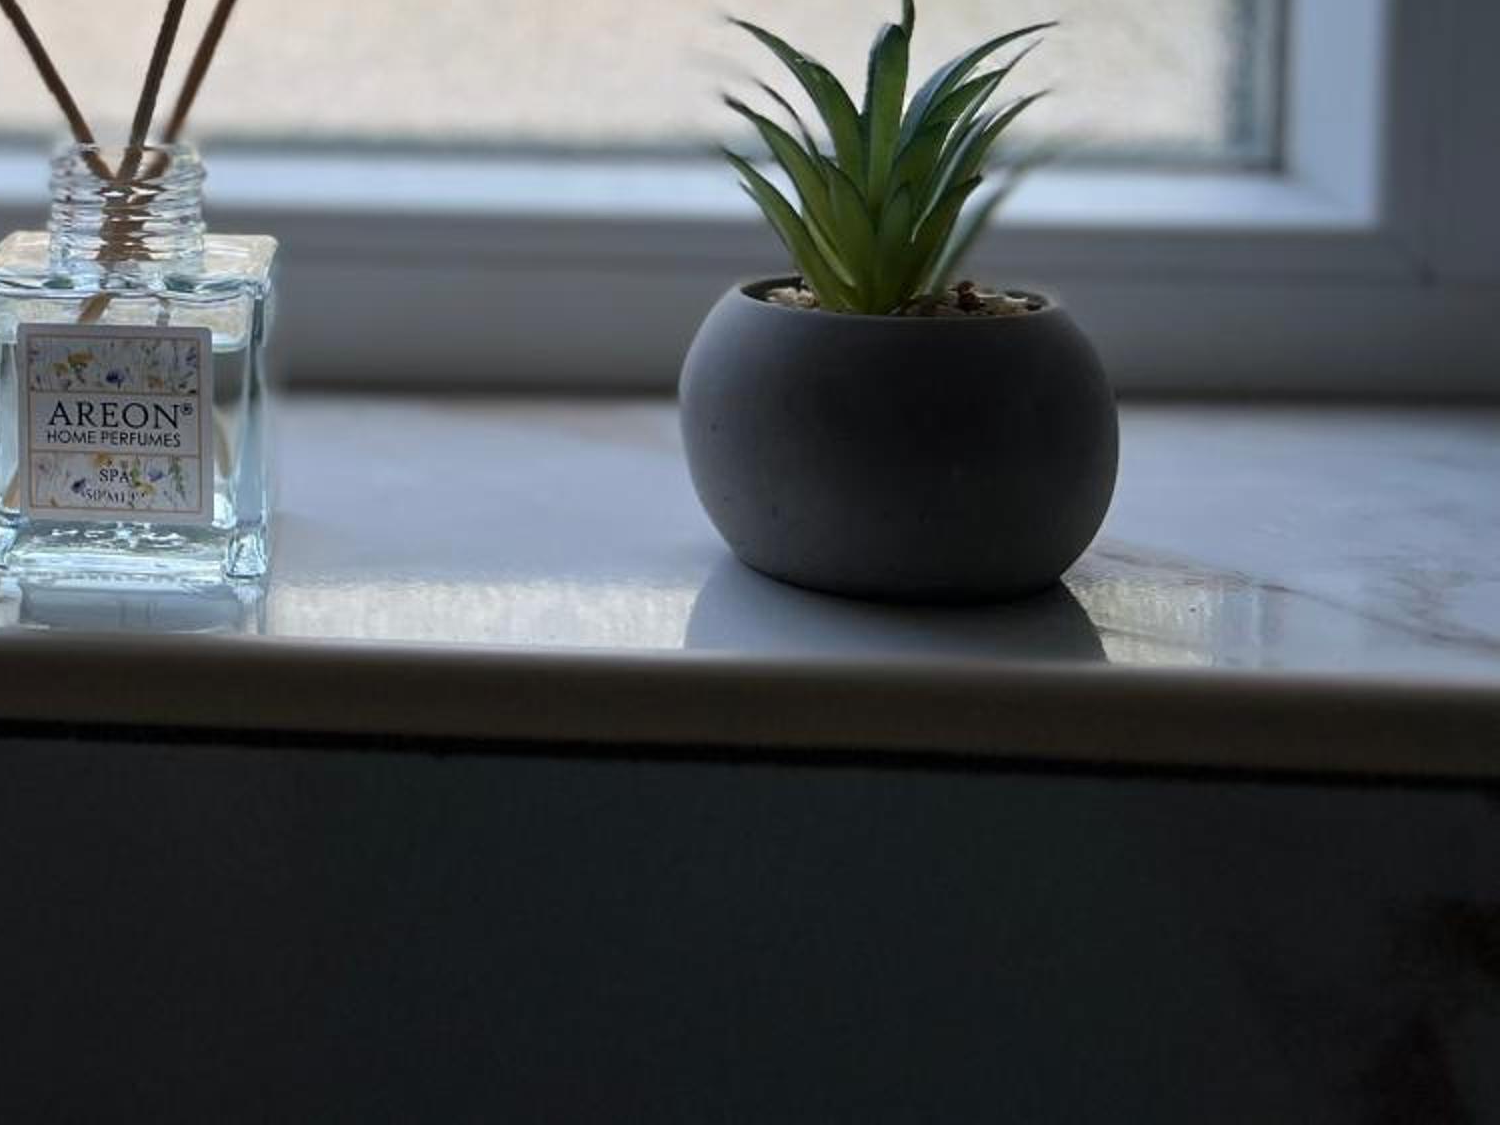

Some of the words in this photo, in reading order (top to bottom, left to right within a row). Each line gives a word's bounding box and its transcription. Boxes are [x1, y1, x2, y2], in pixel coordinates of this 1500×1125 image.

[46, 430, 97, 444] HOME
[101, 431, 181, 448] PERFUMES
[99, 468, 130, 483] SPA
